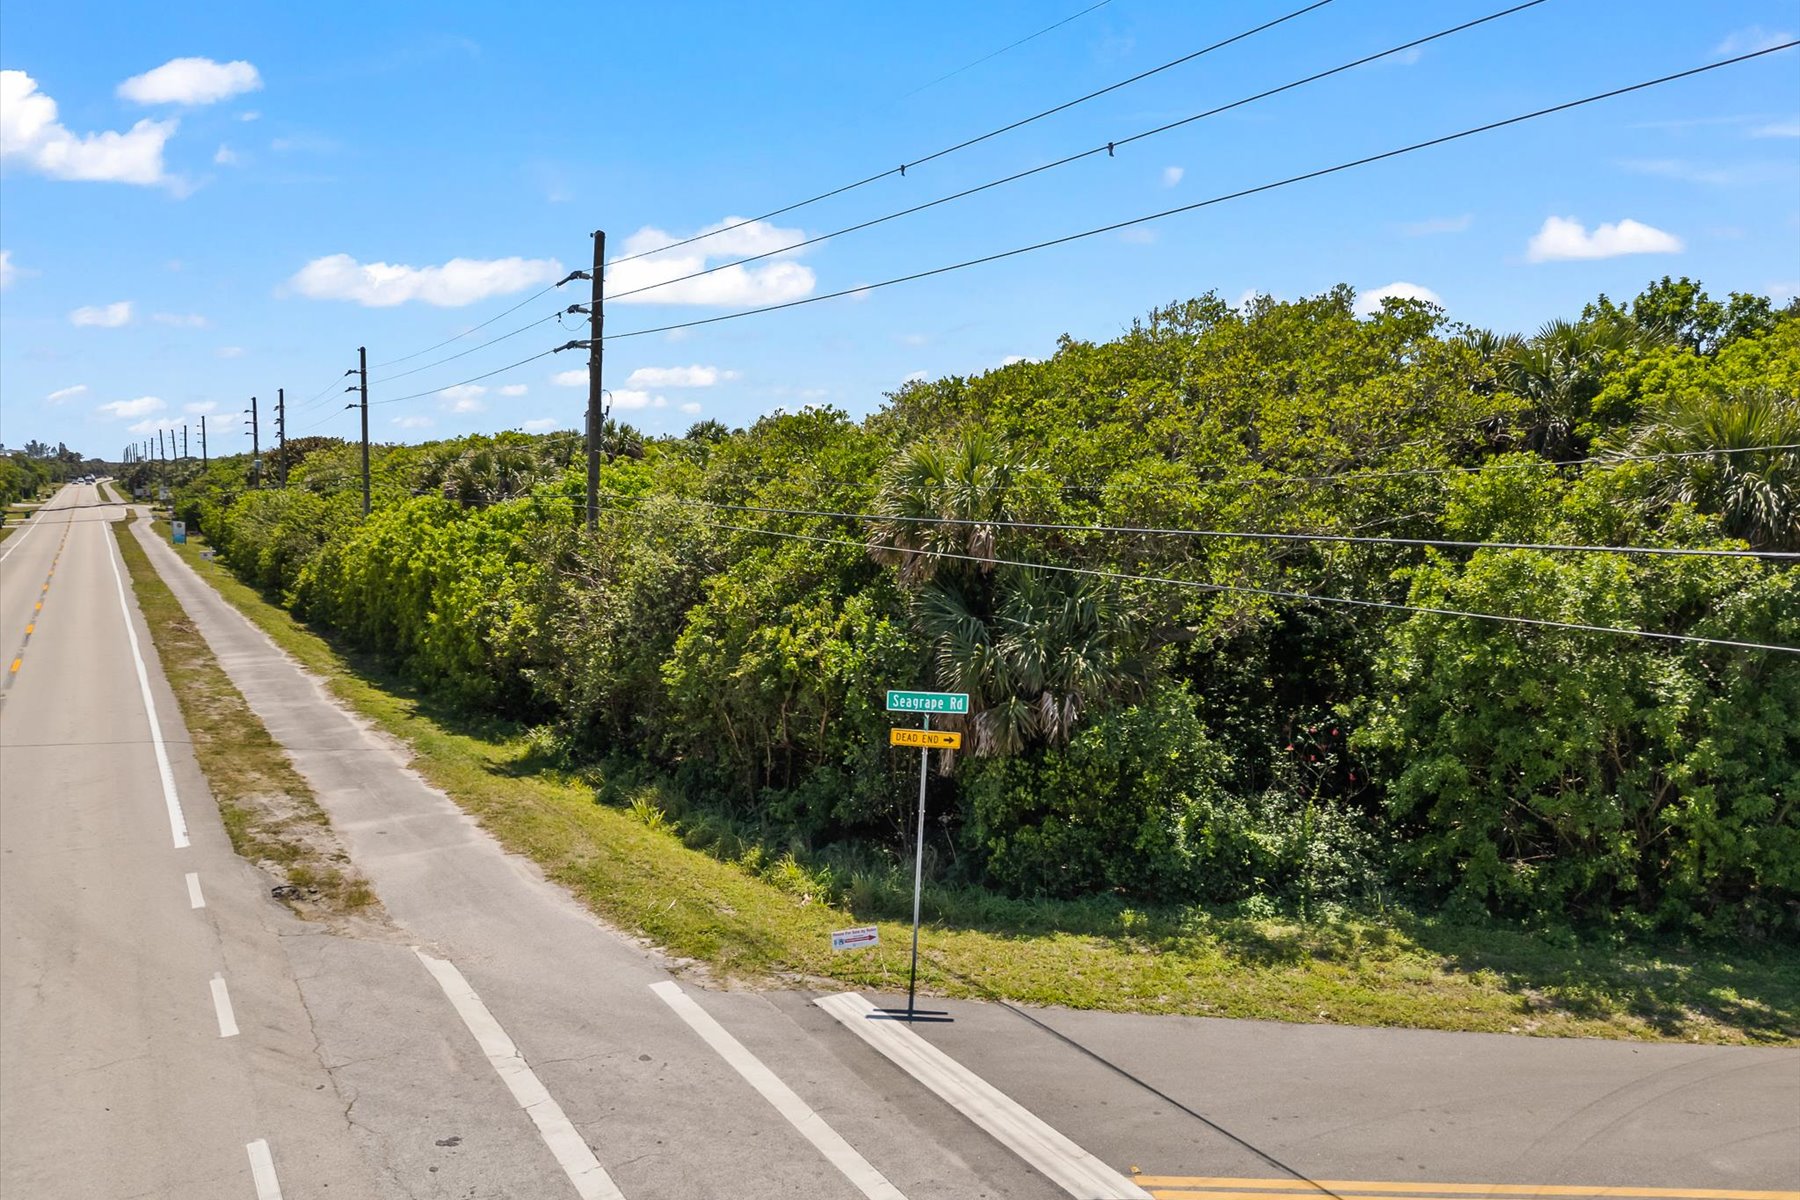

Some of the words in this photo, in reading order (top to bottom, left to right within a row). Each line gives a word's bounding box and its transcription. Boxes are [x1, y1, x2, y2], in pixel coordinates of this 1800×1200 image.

[892, 694, 944, 710] Seagrape
[950, 697, 963, 710] Rd
[895, 732, 918, 743] DEAD
[922, 734, 939, 744] END
